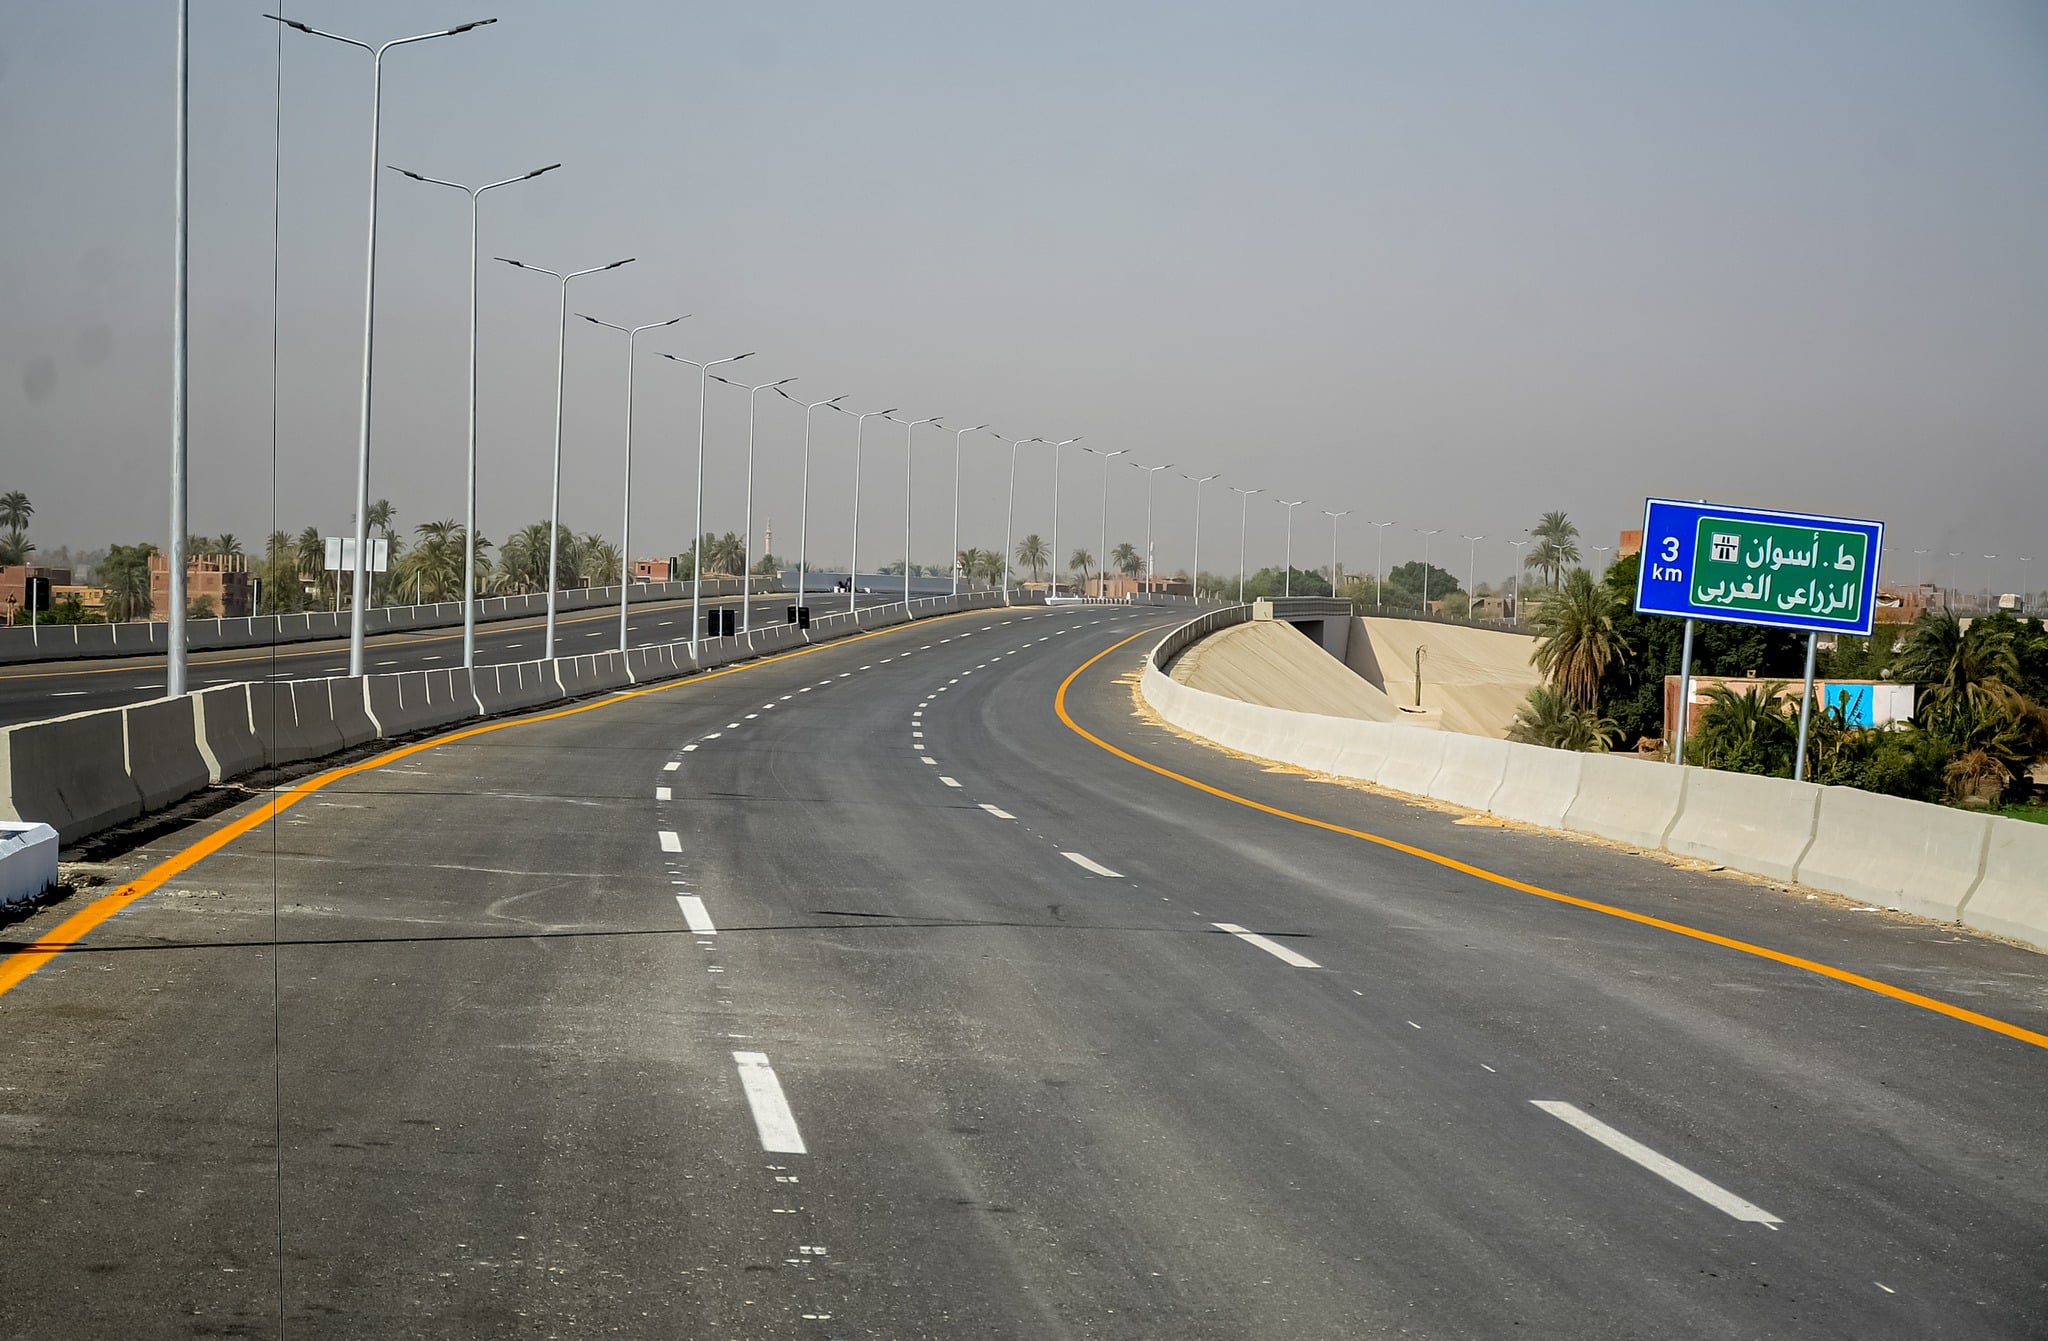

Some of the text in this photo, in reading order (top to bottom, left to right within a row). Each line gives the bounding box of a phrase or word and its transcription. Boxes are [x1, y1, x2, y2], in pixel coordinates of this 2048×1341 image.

[1661, 537, 1680, 562] 3
[1745, 532, 1820, 571] أسوان
[1652, 563, 1683, 582] km
